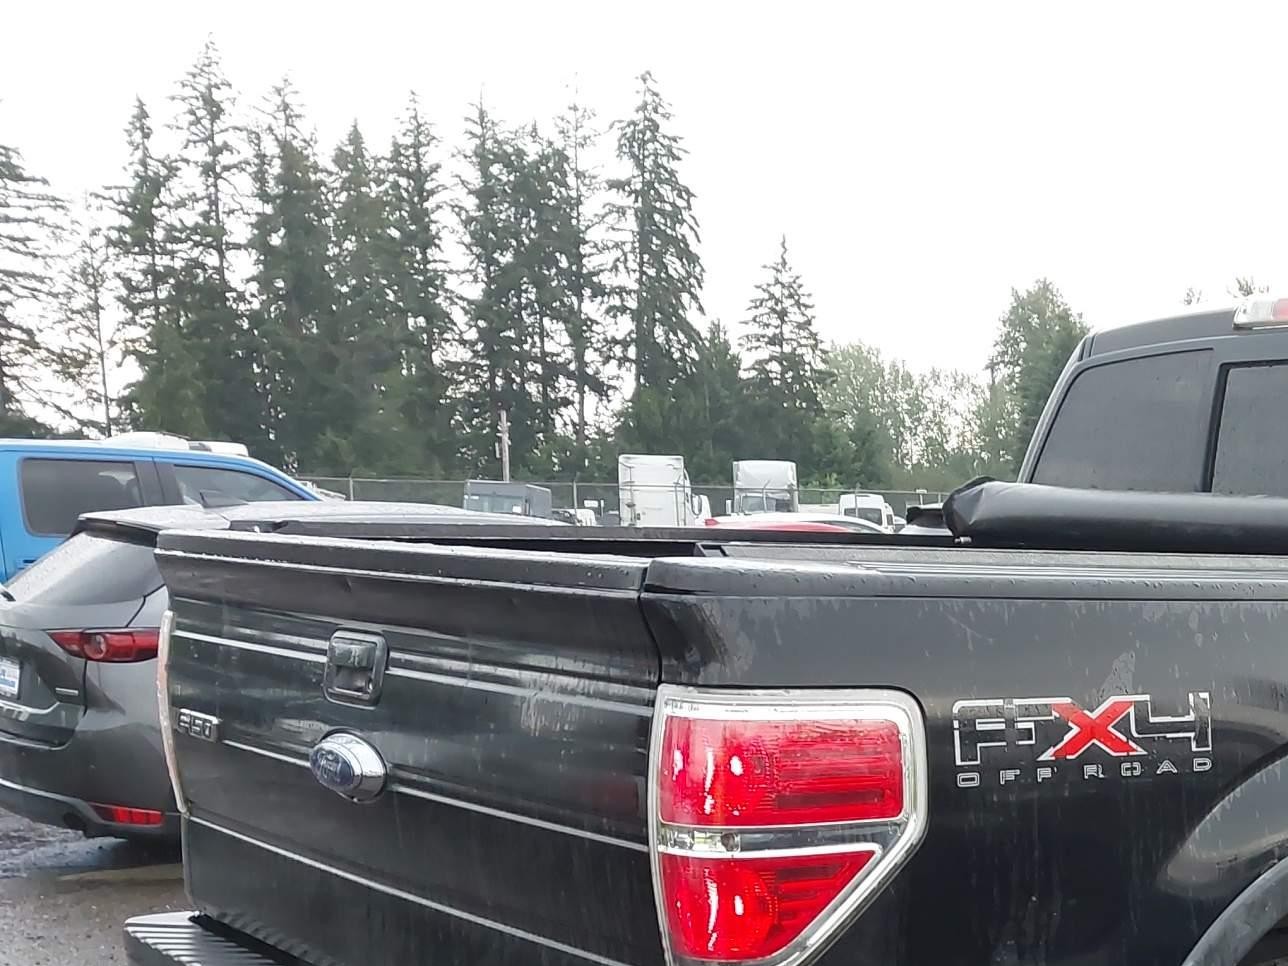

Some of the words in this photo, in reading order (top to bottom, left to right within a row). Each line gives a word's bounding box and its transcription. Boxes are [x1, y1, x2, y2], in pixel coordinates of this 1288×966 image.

[952, 692, 1213, 766] FX4
[956, 768, 1055, 787] OFF
[1083, 757, 1212, 779] ROAD
